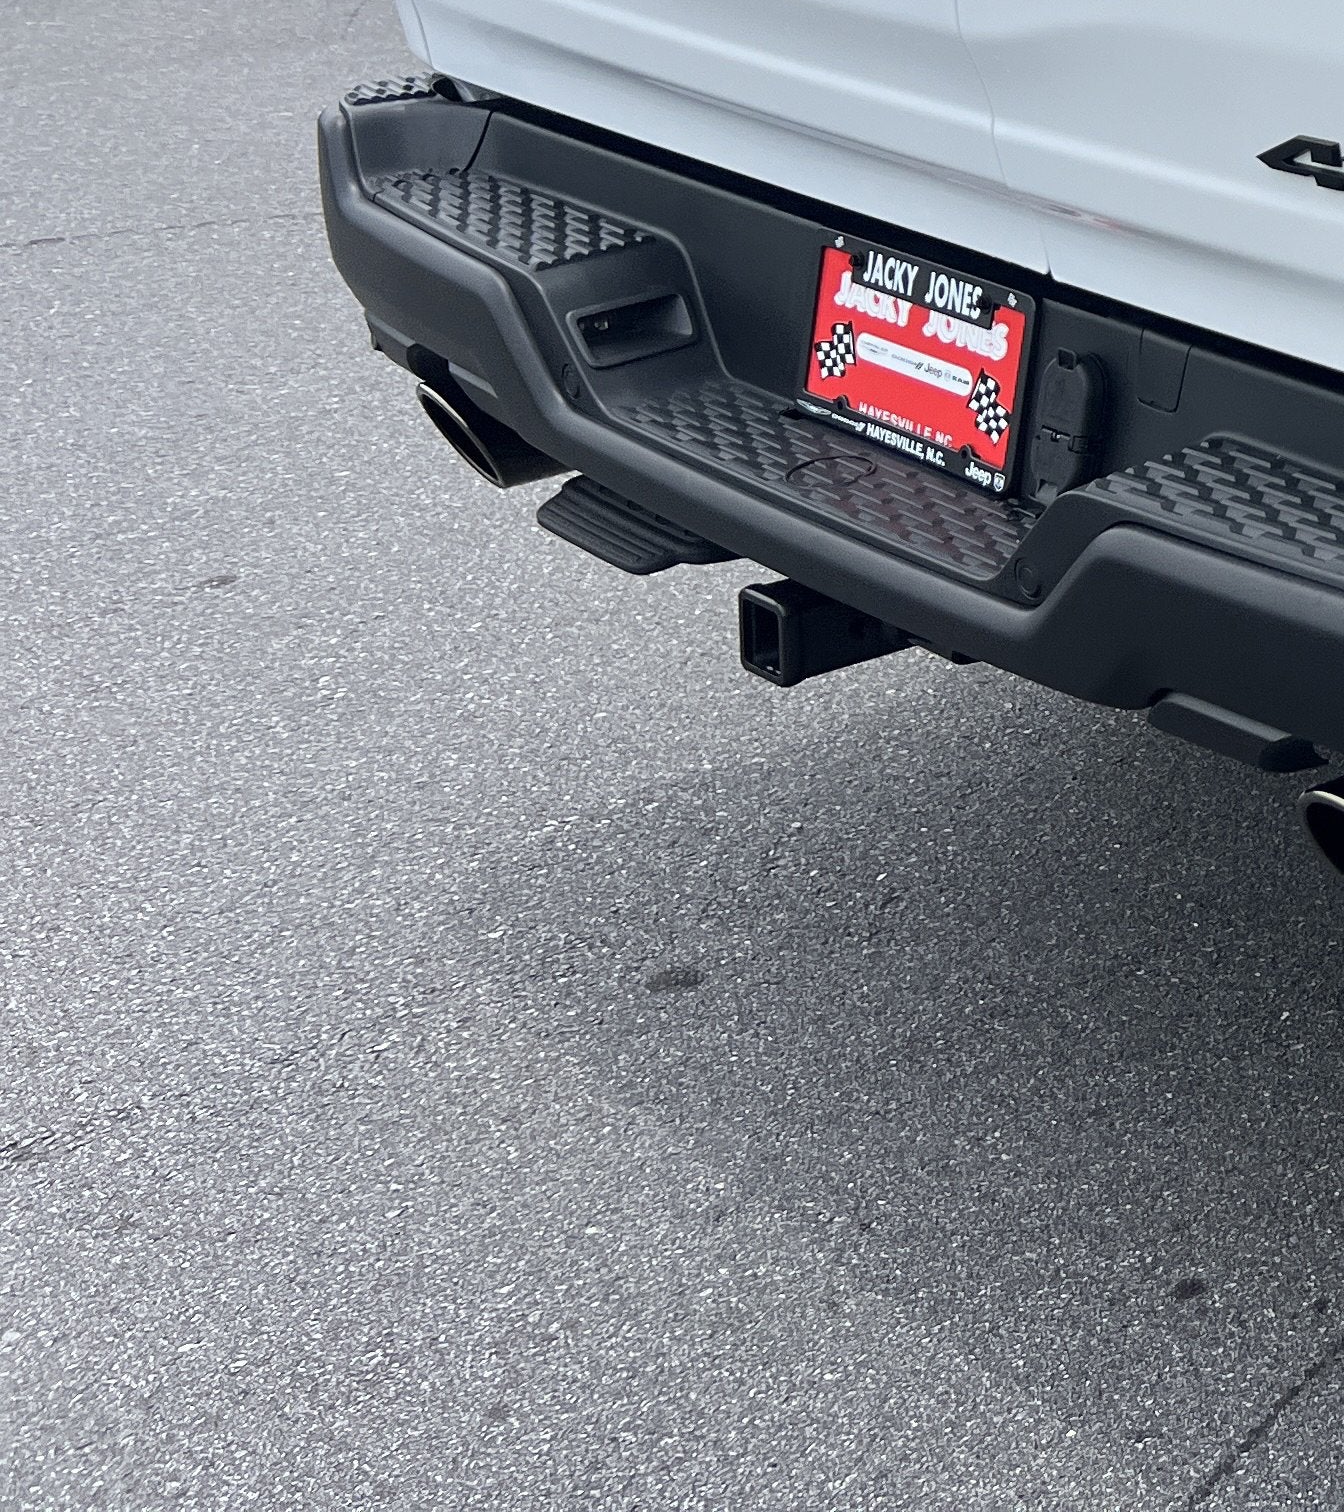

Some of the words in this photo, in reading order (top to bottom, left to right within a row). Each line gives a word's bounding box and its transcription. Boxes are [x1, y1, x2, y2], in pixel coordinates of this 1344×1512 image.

[862, 250, 919, 297] JACKY
[925, 271, 983, 320] JONES
[924, 362, 943, 379] Jeep
[866, 422, 924, 460] HAYESVILLE,
[964, 461, 992, 486] Jeep
